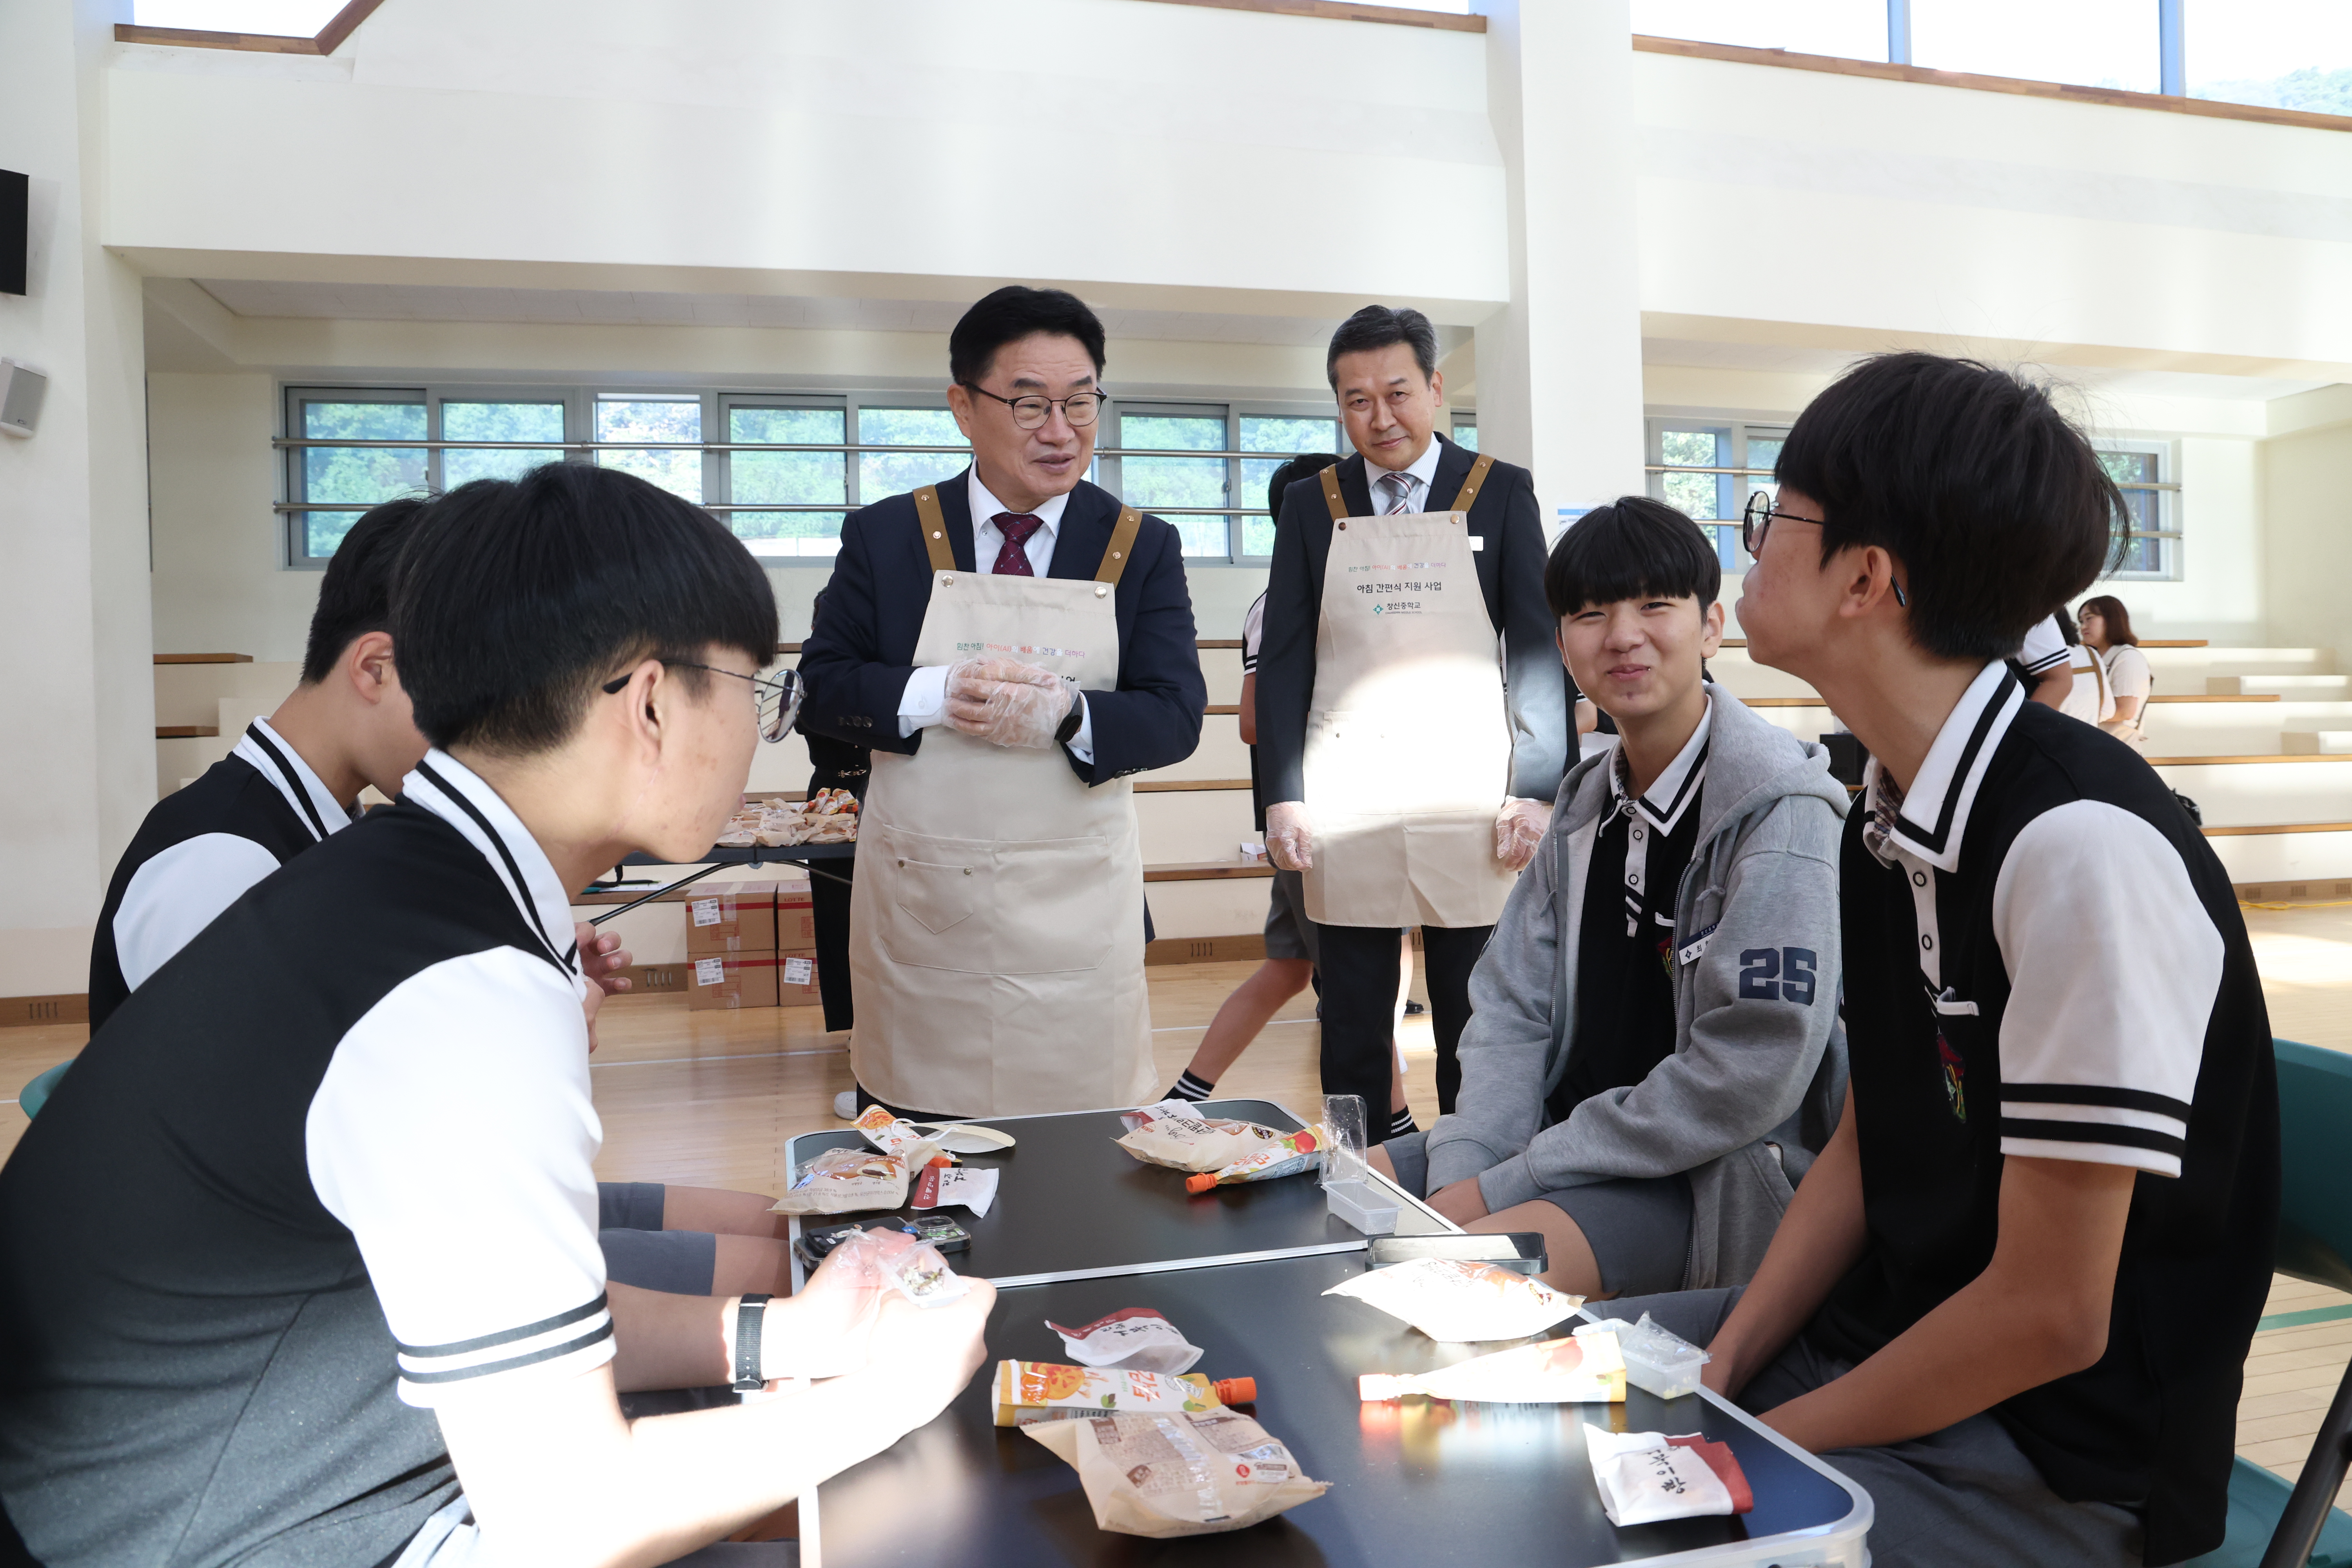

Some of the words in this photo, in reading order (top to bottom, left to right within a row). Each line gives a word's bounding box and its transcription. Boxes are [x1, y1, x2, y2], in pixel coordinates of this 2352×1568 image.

[1357, 584, 1373, 594] 아침
[1376, 583, 1402, 593] 간편식
[1405, 582, 1421, 592] 지원
[1424, 581, 1442, 591] 사업
[1387, 602, 1421, 610] 창신중학교
[957, 642, 970, 651] 힘찬
[986, 643, 1018, 653] 아이(AI)의
[1020, 646, 1040, 655] 배움에
[1043, 647, 1063, 657] 건강을
[1065, 650, 1085, 659] 더하다
[1739, 946, 1817, 1006] 25
